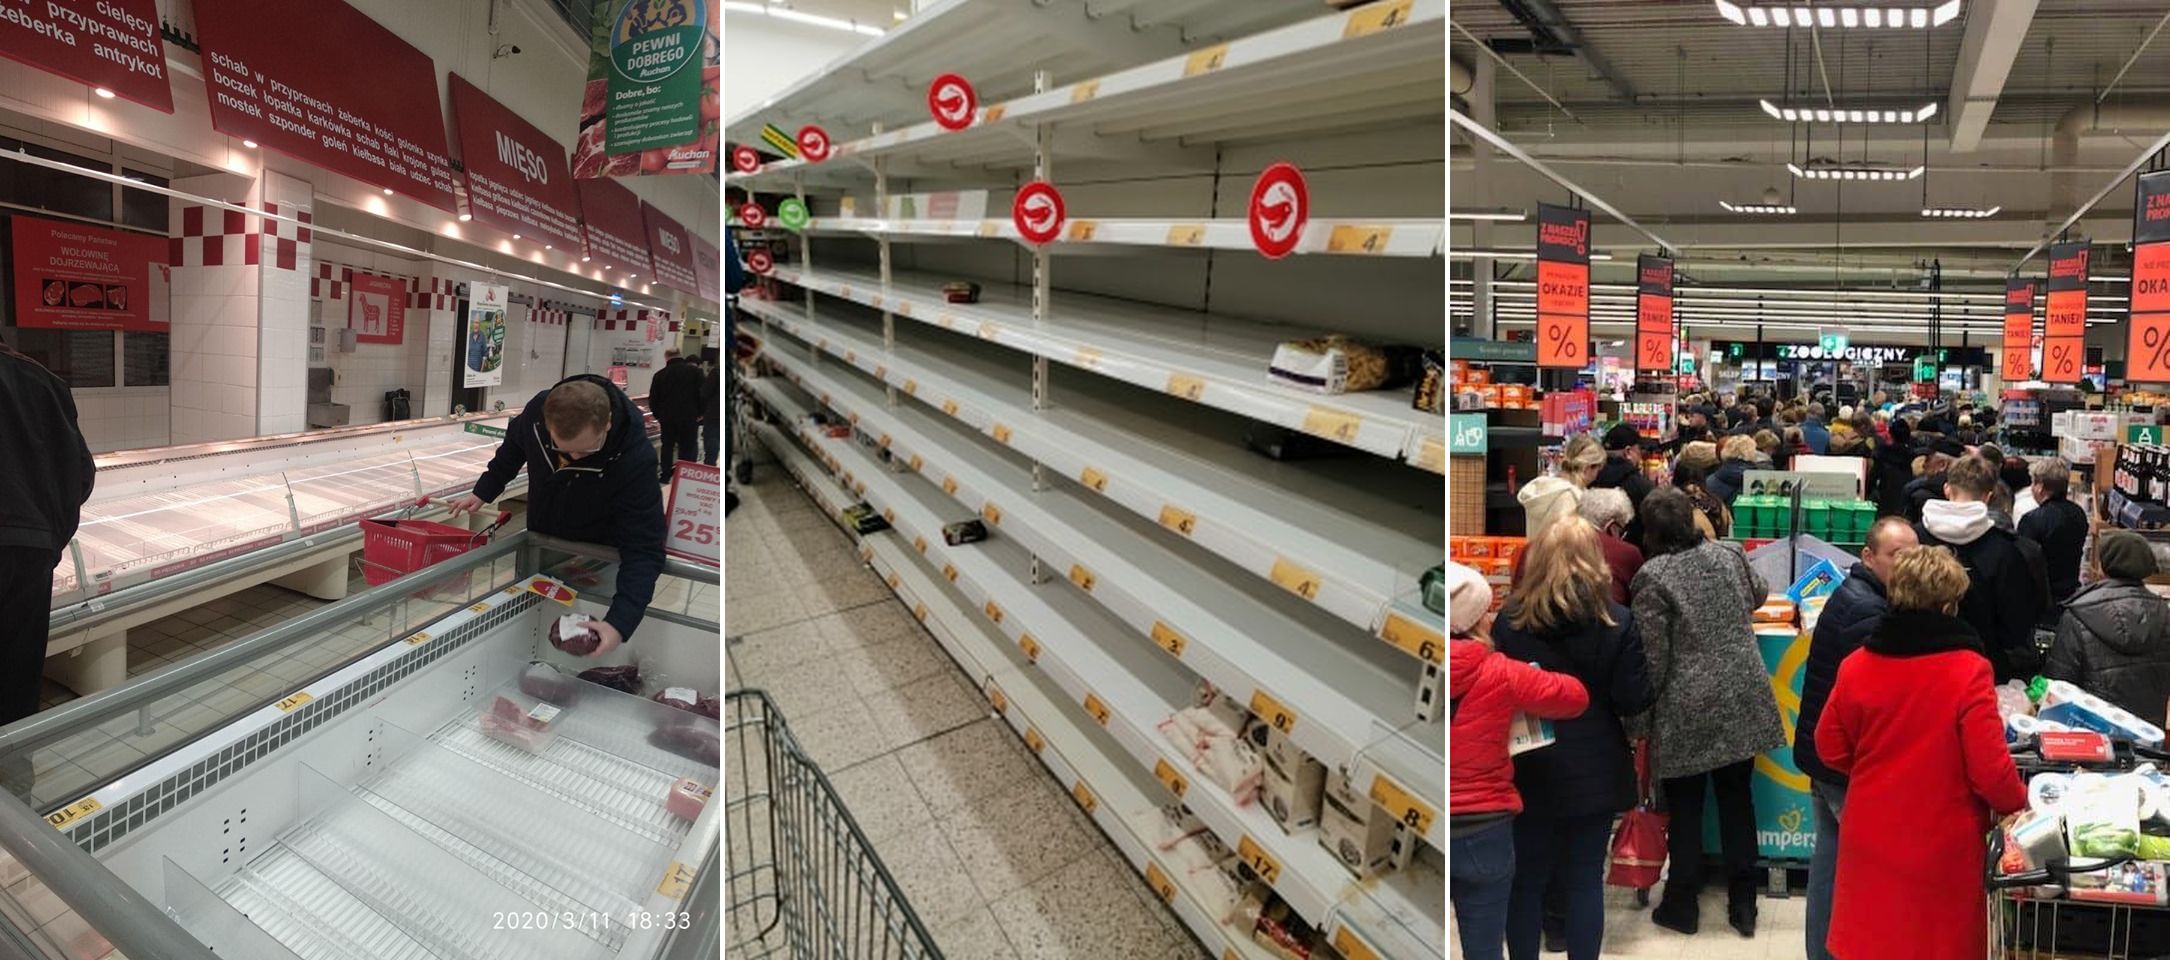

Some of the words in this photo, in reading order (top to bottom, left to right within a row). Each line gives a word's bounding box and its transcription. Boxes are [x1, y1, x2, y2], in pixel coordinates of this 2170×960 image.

[48, 3, 158, 56] przyprawach
[96, 1, 153, 36] cielęcy
[632, 32, 681, 55] PEWNI
[93, 43, 162, 79] antrykot
[627, 47, 684, 71] DOBREGO
[639, 65, 671, 78] Auchan
[211, 51, 249, 77] schab
[255, 71, 265, 84] w
[270, 78, 334, 115] przyprawach
[338, 107, 371, 132] żeberka
[374, 123, 395, 143] kości
[397, 137, 424, 156] golonka
[615, 87, 645, 101] Dobre,
[645, 85, 662, 96] bo:
[213, 68, 257, 99] boczek
[263, 89, 303, 118] łopatka
[307, 109, 352, 138] karkówka
[356, 131, 380, 150] schab
[384, 142, 400, 159] flaki
[402, 151, 428, 171] krojone
[217, 91, 262, 119] mostek
[268, 110, 317, 141] szponder
[322, 133, 348, 153] goleń
[352, 144, 386, 167] kiełbasa
[495, 130, 548, 185] MIĘSO
[668, 149, 709, 160] Auchan
[51, 230, 87, 243] Polecamy
[49, 256, 120, 274] DOJRZEWAJĄCĄ
[1542, 282, 1585, 298] OKAZJE
[1418, 639, 1435, 661] 6
[1274, 712, 1287, 729] 9
[1403, 806, 1421, 828] 8
[1252, 855, 1273, 876] 17
